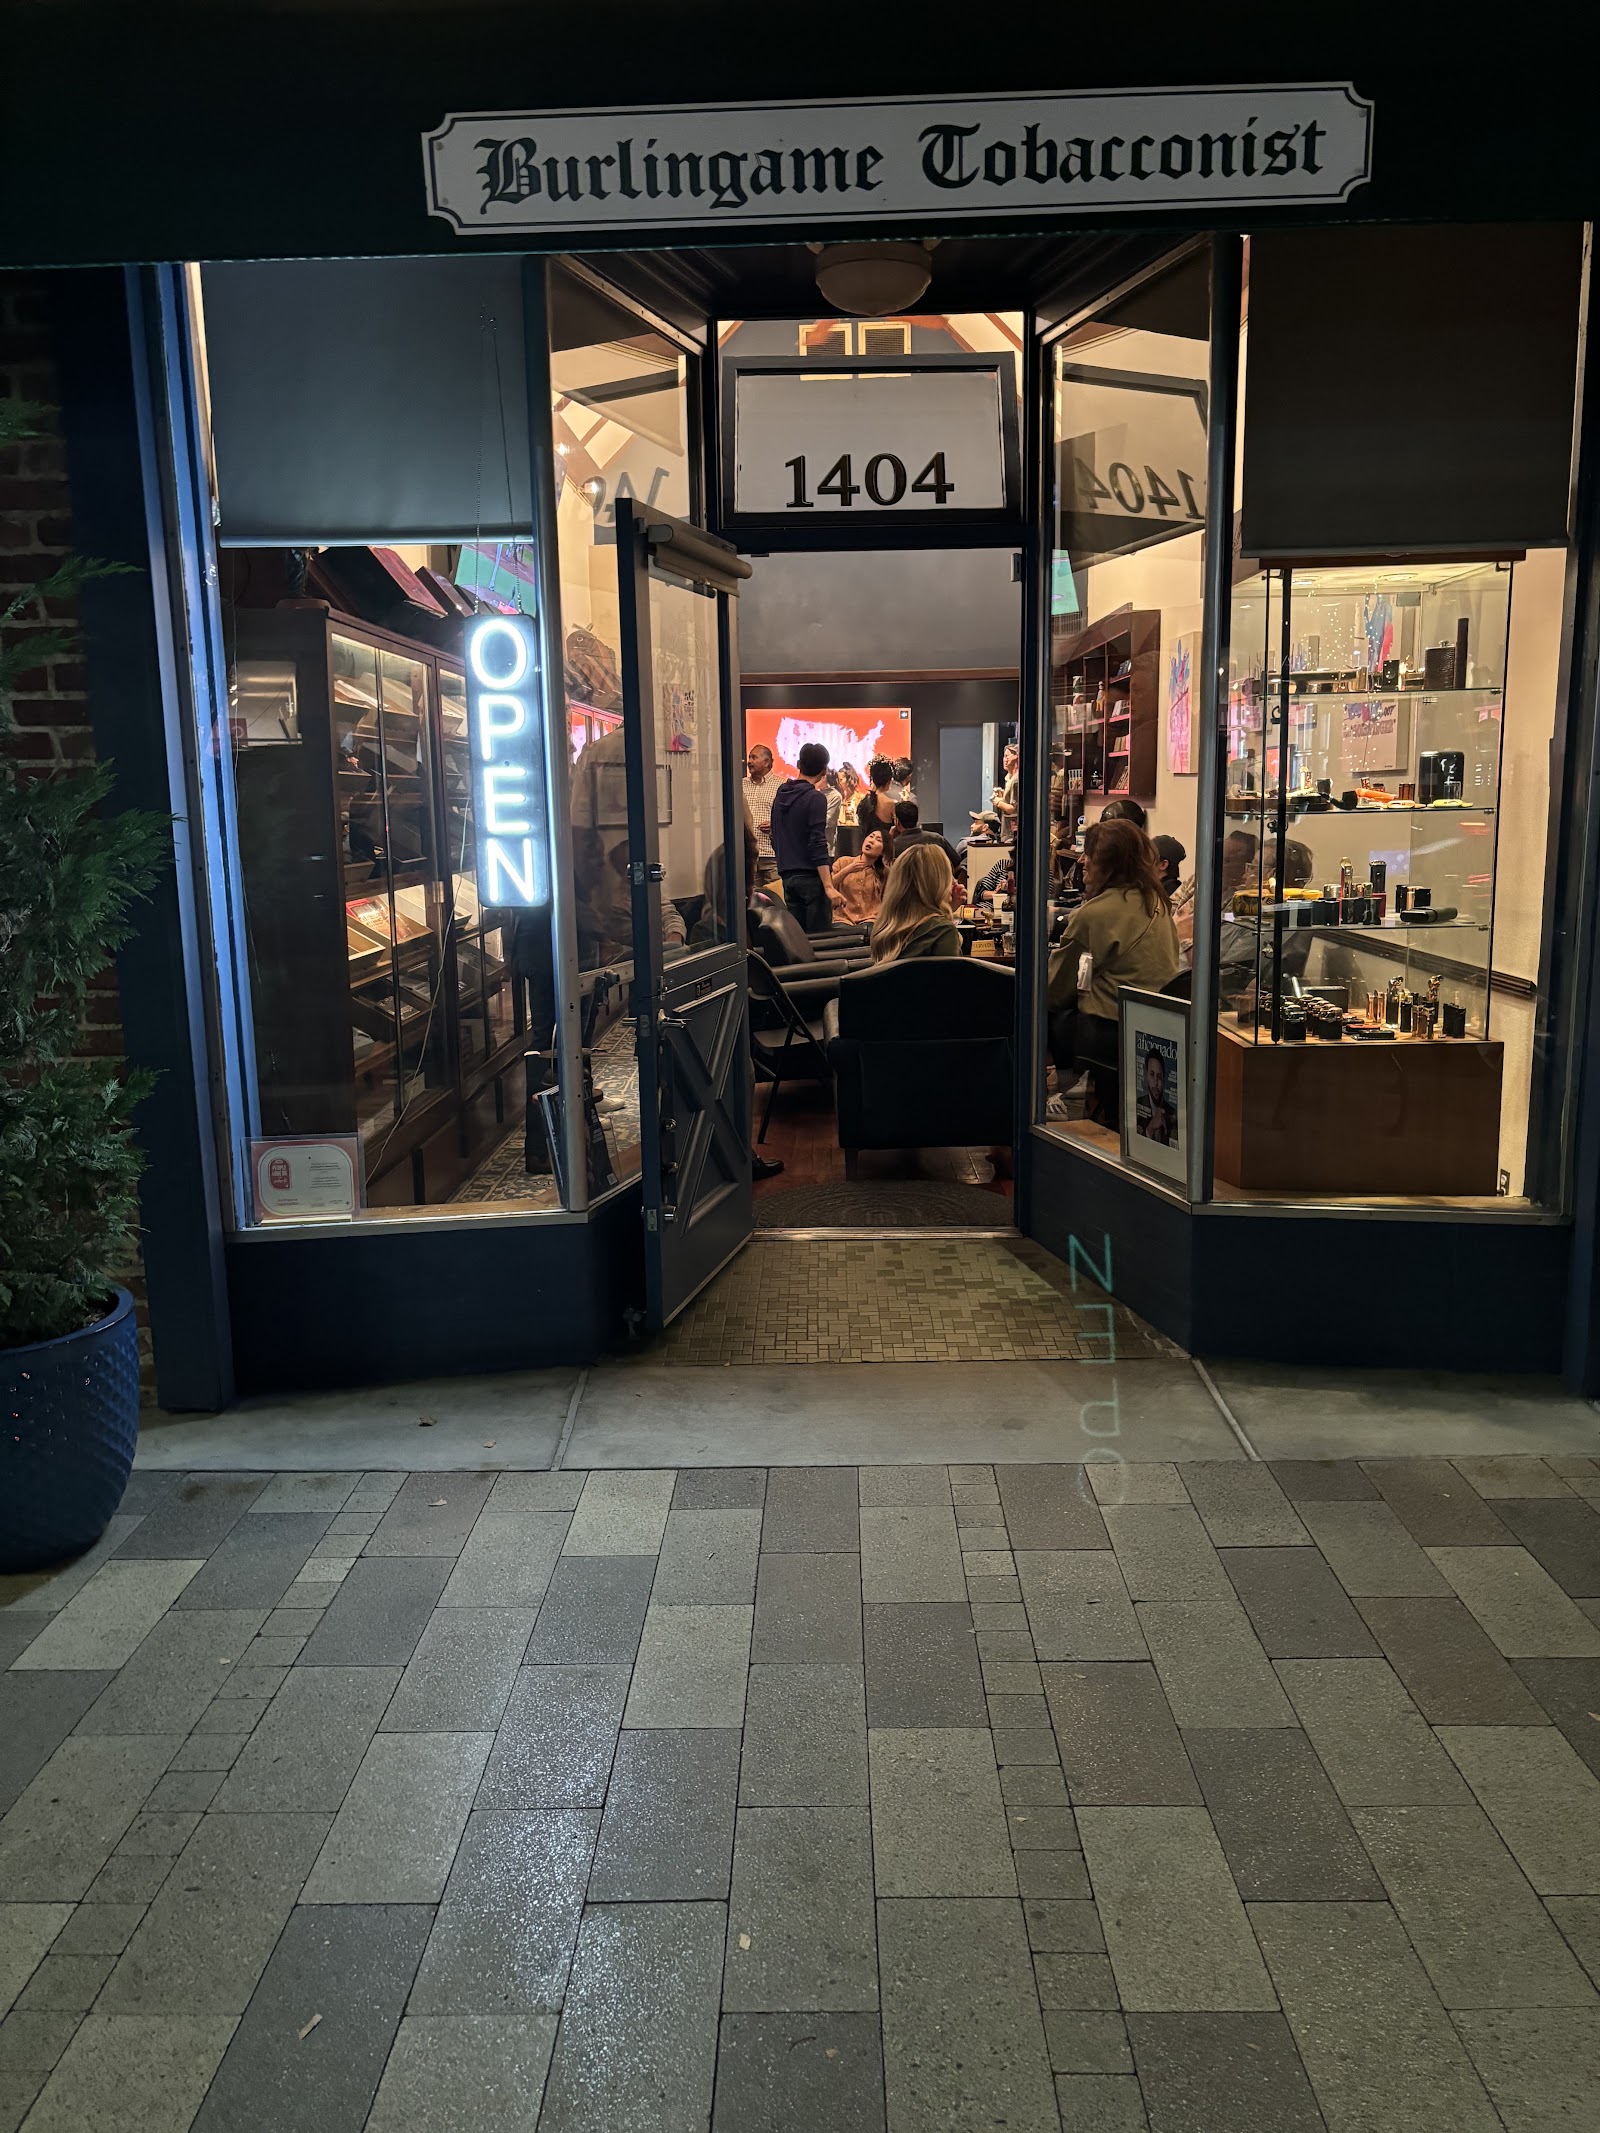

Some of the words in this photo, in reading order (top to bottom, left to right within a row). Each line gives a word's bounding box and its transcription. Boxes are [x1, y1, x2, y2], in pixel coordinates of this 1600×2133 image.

[474, 137, 882, 214] Burlingame
[918, 118, 1328, 188] Tobacconist
[785, 451, 955, 508] 1404
[470, 618, 536, 903] OPEN
[1068, 1233, 1128, 1511] OPEN
